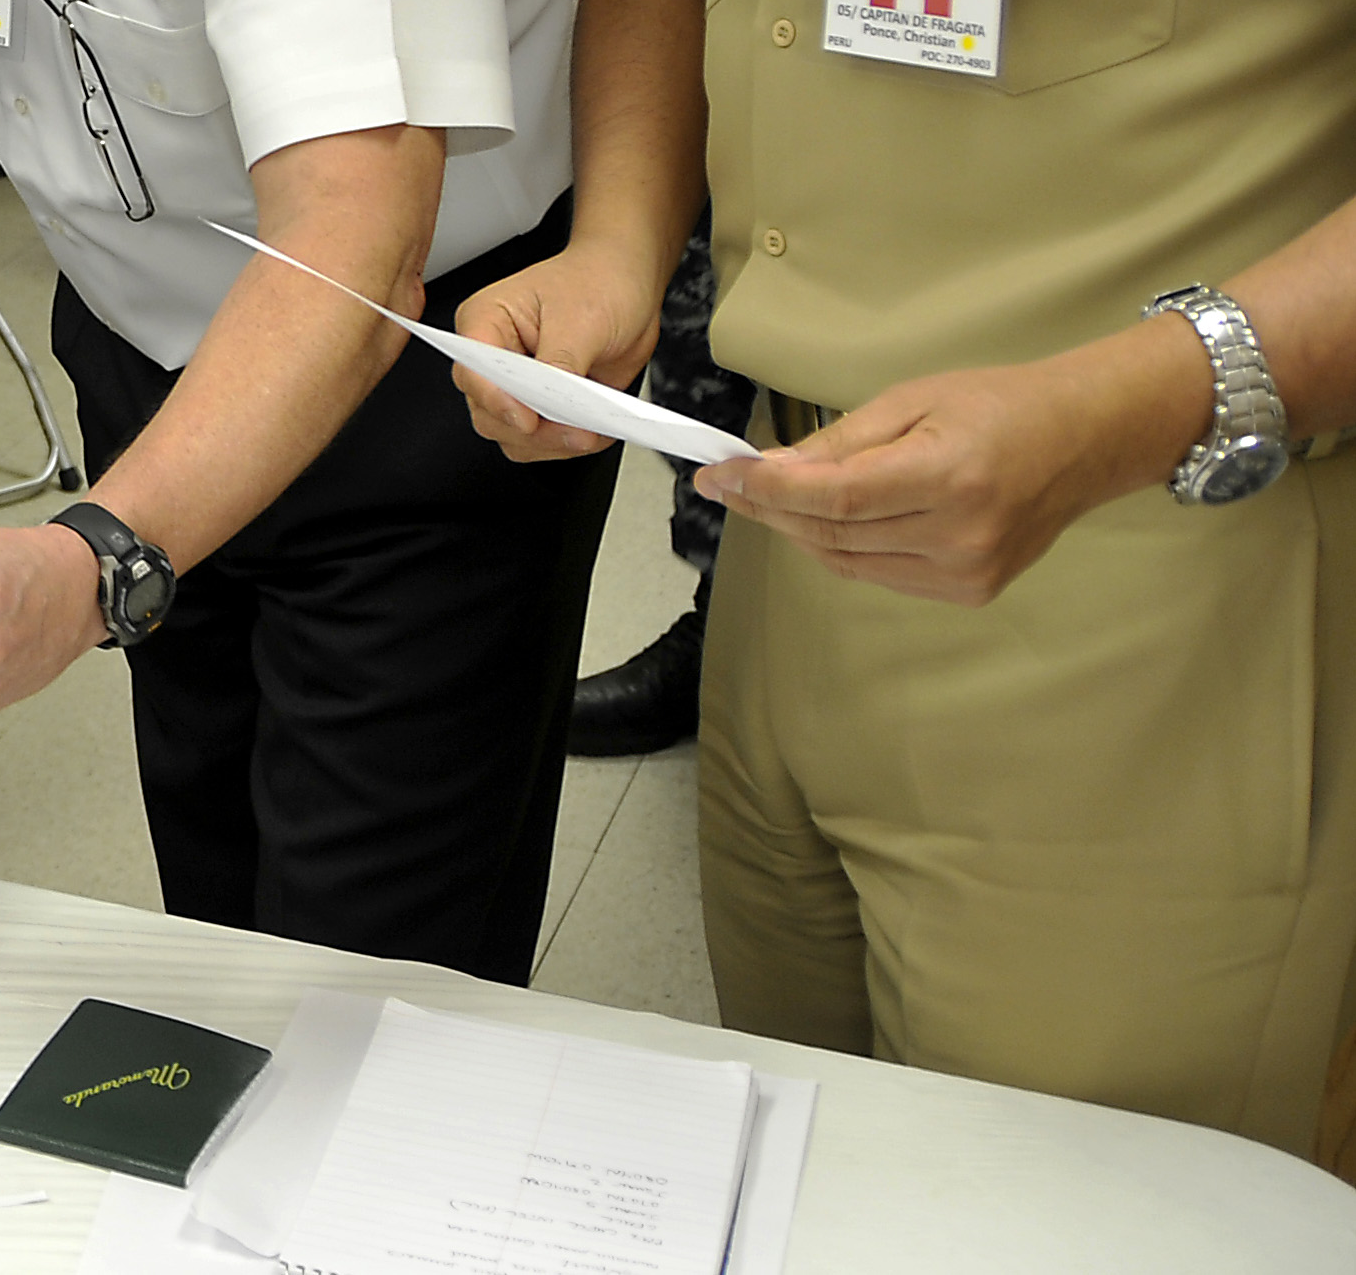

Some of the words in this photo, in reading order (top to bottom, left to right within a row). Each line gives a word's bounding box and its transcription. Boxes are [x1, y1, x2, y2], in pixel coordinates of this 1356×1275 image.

[860, 7, 910, 26] CAPITAN
[912, 14, 928, 28] DE
[931, 17, 985, 39] FRAGATA
[863, 23, 900, 42] Ponce,
[904, 28, 956, 49] Christian
[828, 35, 852, 49] PERU
[62, 1061, 191, 1108] Memoranda
